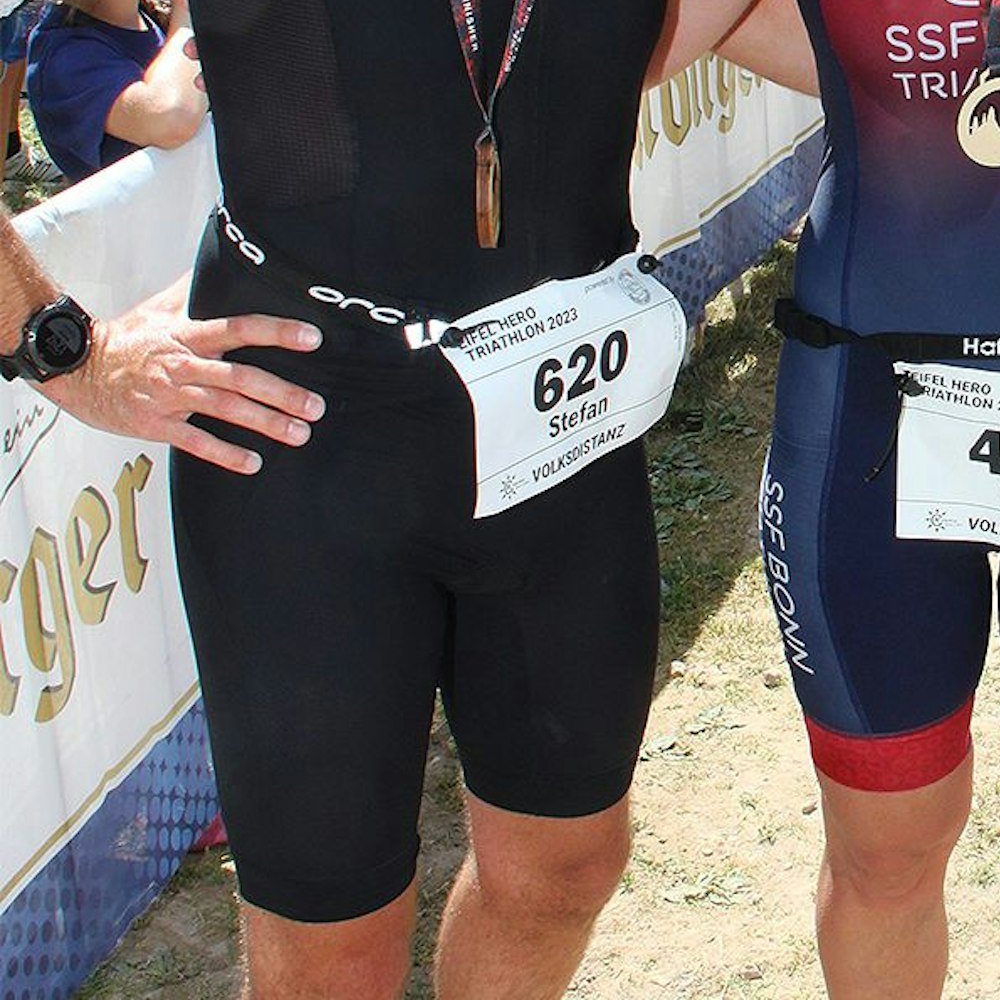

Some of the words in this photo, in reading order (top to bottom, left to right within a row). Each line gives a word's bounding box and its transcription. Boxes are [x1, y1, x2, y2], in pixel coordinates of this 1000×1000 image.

[885, 20, 978, 62] SSF
[465, 321, 547, 362] TRIATHLON
[549, 307, 579, 330] 2023
[499, 306, 537, 330] HERO
[533, 329, 628, 413] 620
[951, 380, 992, 396] HERO
[549, 397, 609, 438] Stefan
[923, 386, 993, 409] RIATHLON
[532, 423, 626, 482] VOLKSDISTANZ
[763, 474, 786, 542] SSF
[768, 551, 816, 675] BONN
